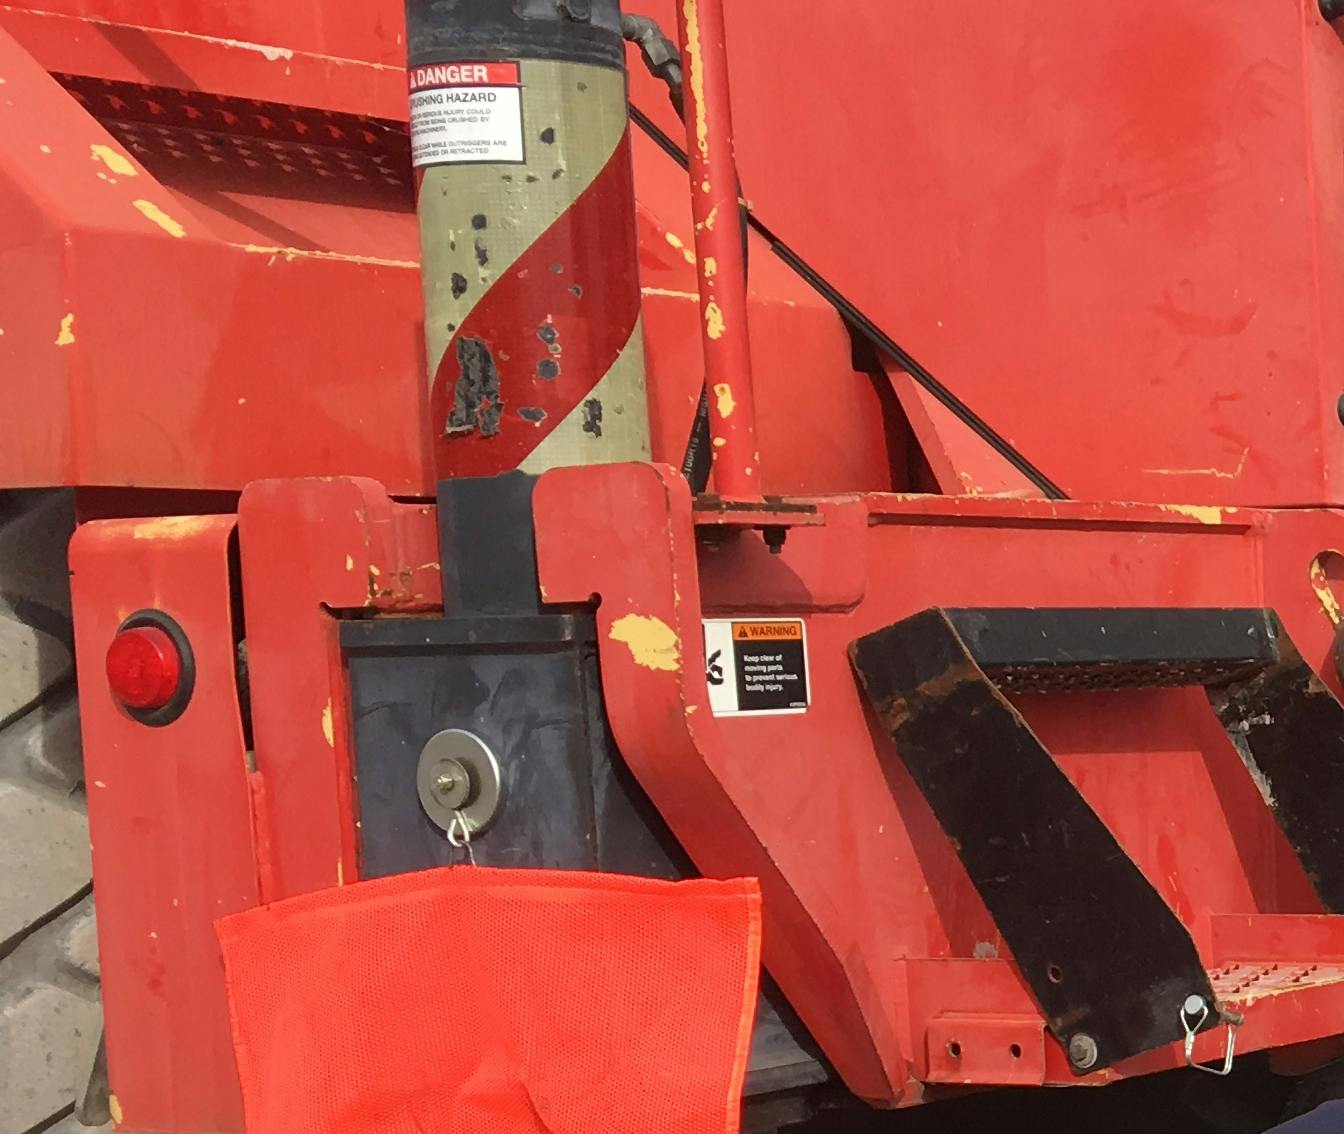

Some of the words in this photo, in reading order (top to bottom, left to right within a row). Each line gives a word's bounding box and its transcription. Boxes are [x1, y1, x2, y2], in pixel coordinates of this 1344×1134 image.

[417, 65, 489, 86] DANGER
[447, 92, 497, 103] HAZARD
[749, 626, 797, 636] WARNING
